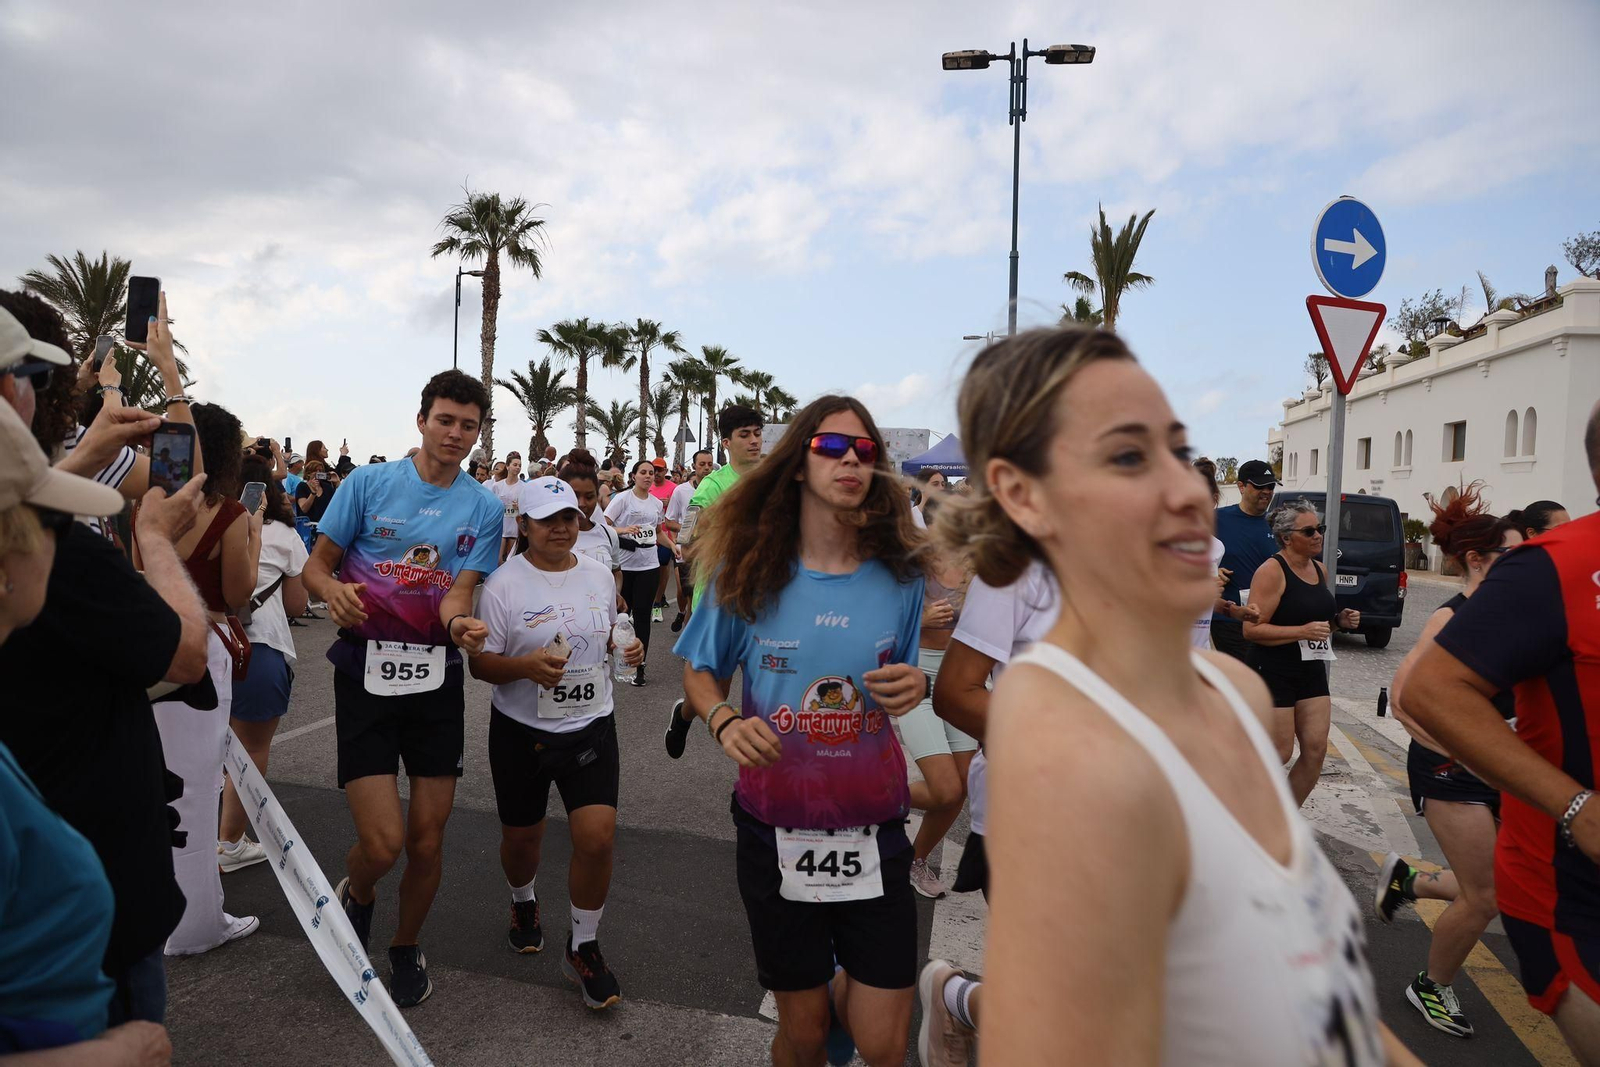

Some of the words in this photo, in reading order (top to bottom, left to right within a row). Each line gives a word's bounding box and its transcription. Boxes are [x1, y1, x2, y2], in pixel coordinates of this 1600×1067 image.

[1340, 575, 1354, 584] HNR
[1308, 640, 1329, 650] 628
[381, 661, 430, 681] 955
[553, 683, 595, 703] 548
[795, 849, 862, 877] 445
